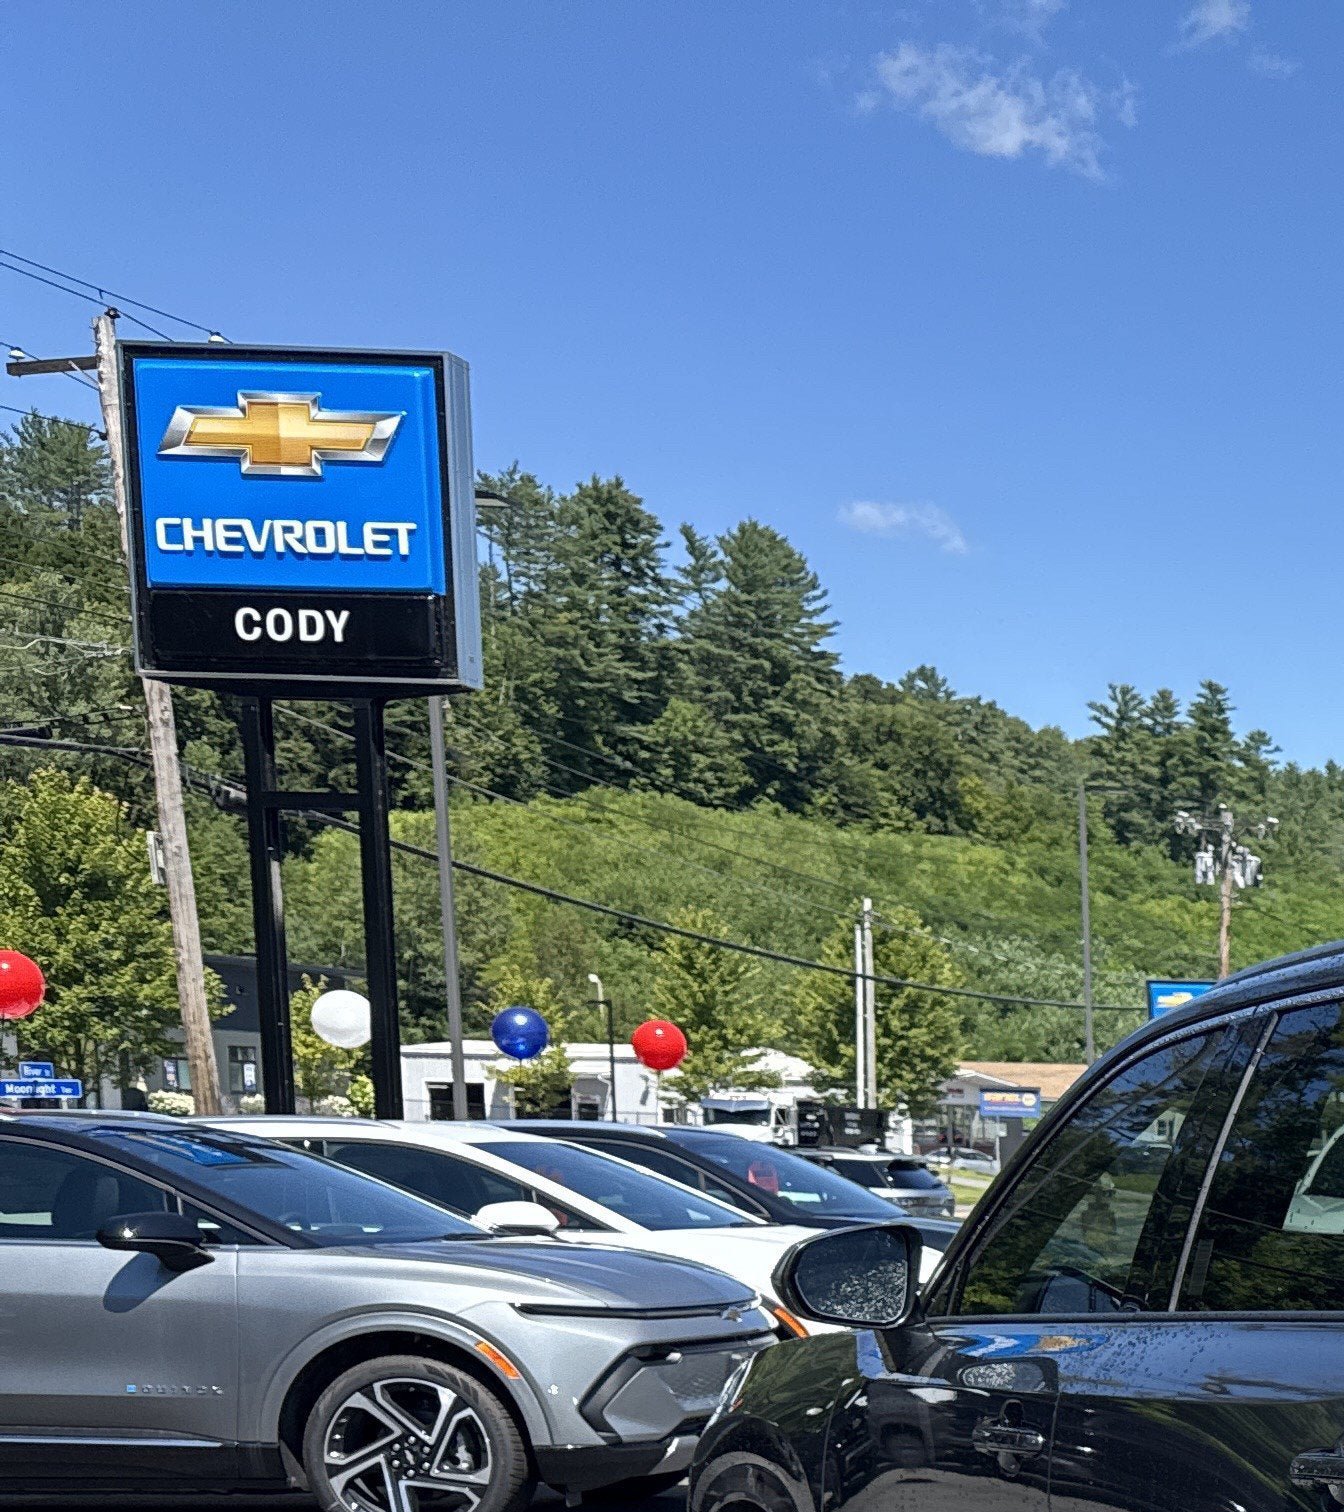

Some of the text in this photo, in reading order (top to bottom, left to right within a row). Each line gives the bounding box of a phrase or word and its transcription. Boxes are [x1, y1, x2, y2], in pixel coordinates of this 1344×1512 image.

[155, 517, 418, 557] CHEVROLET
[234, 606, 350, 644] CODY
[5, 1083, 57, 1097] Moonight
